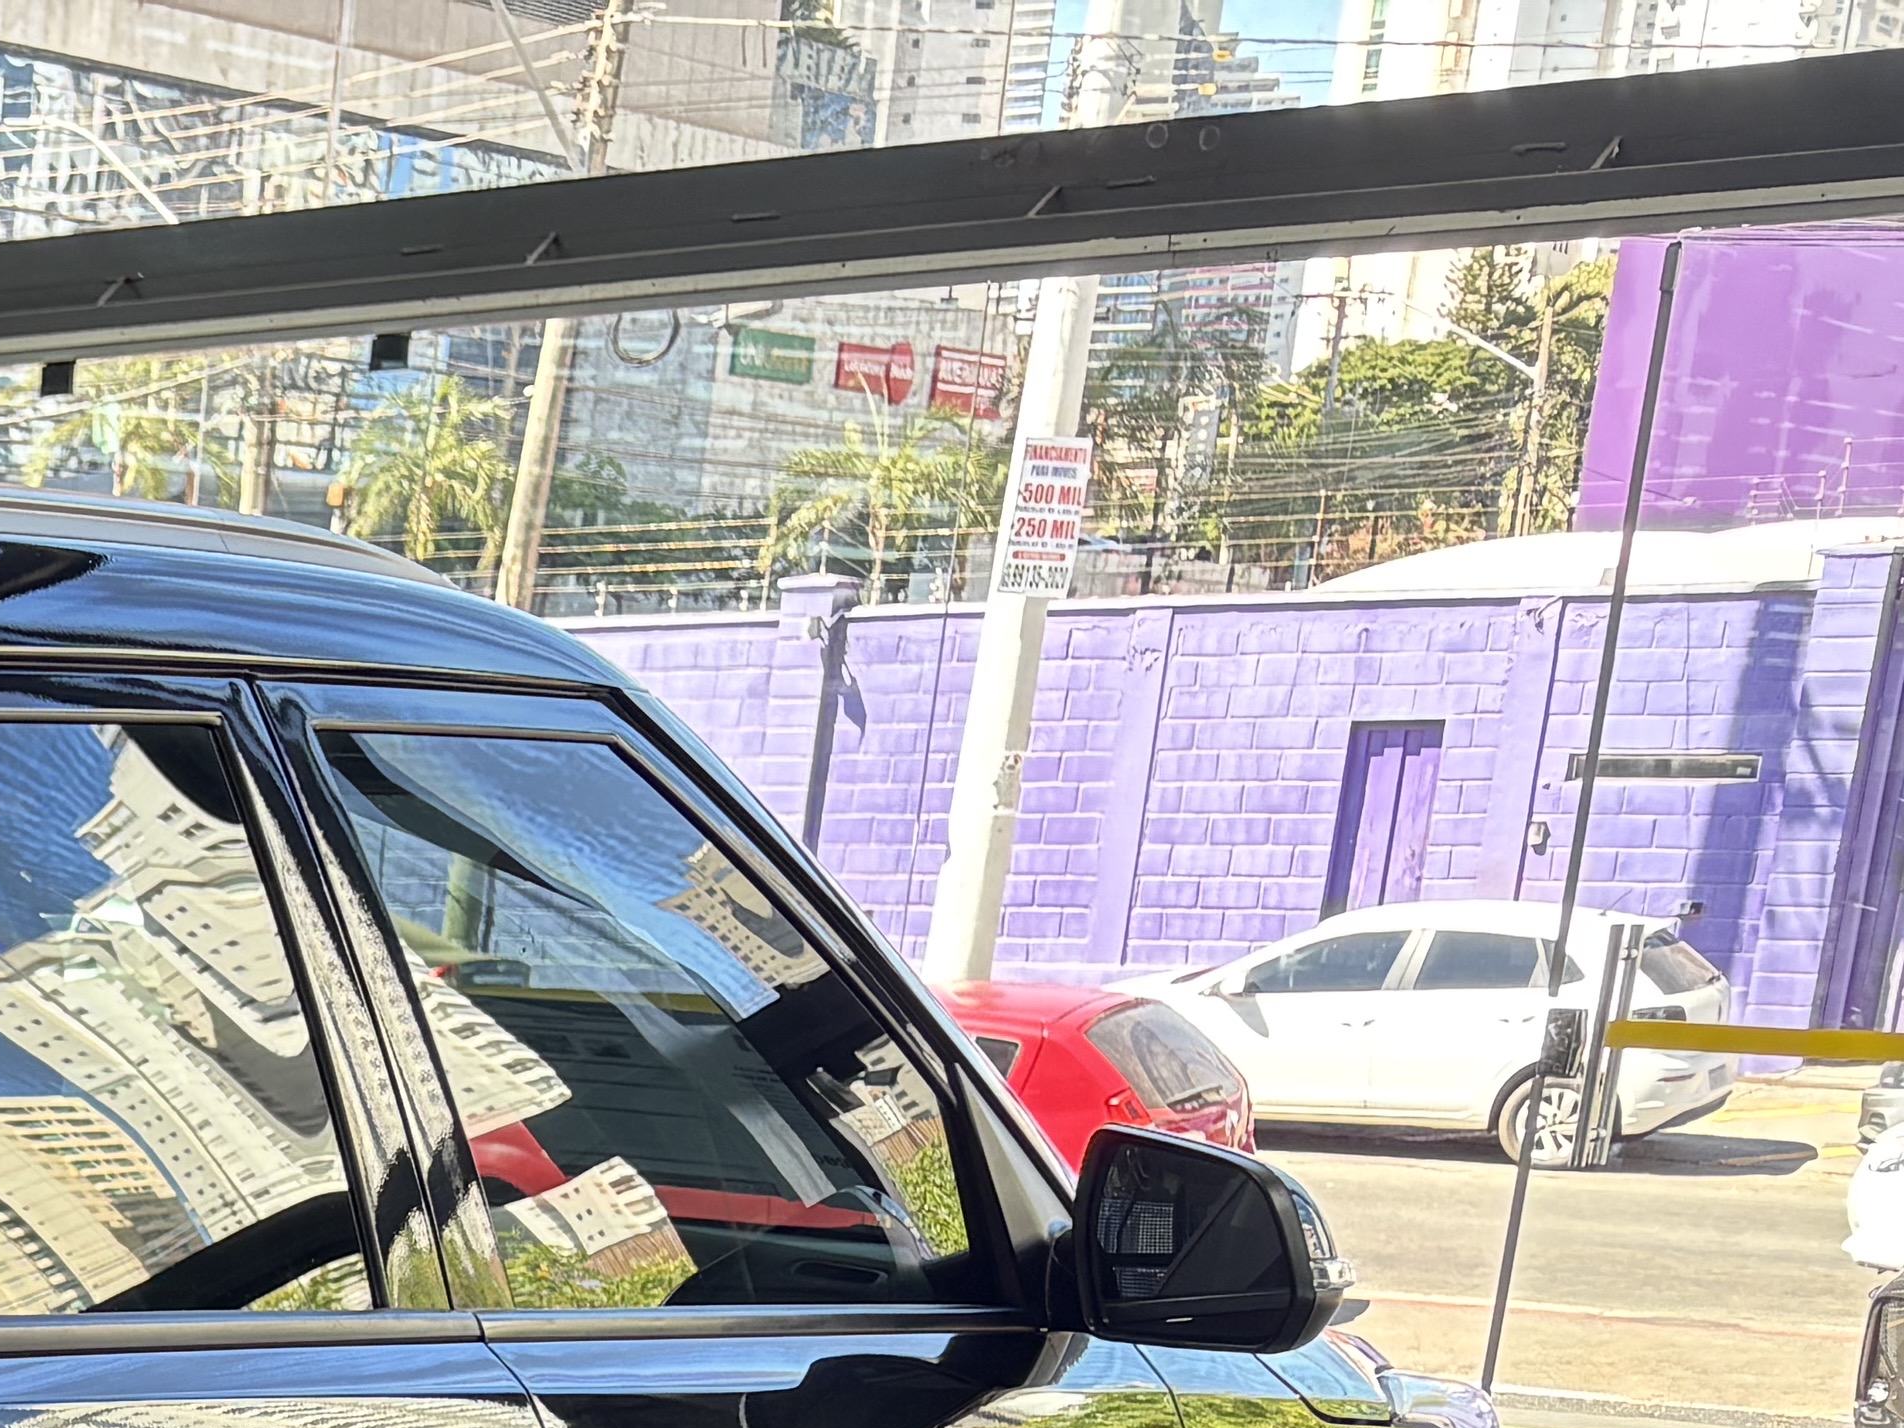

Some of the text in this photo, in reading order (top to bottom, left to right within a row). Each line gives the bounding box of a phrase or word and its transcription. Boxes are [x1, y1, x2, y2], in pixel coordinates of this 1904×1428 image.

[1023, 482, 1082, 507] 500 MIL
[1014, 516, 1076, 540] 250 MIL
